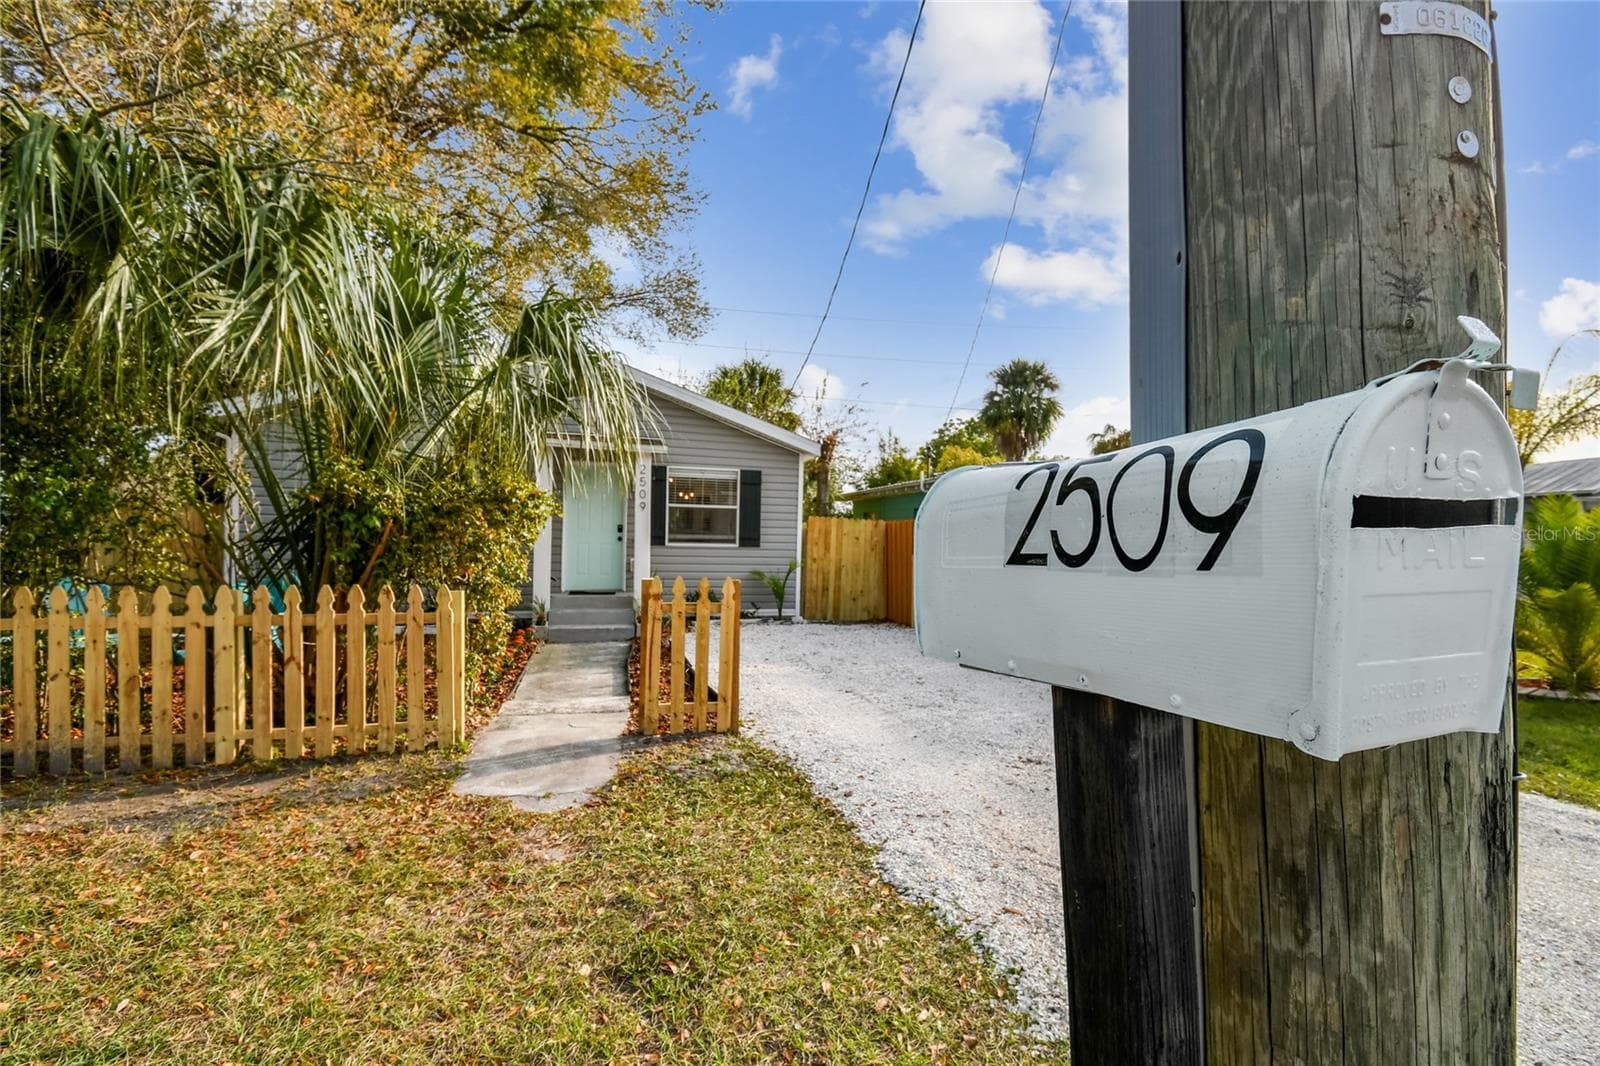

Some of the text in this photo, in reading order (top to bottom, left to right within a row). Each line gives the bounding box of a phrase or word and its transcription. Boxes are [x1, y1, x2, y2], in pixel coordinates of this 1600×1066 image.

[639, 465, 647, 512] 2509
[1005, 428, 1266, 572] 2509
[1377, 528, 1486, 571] MAIL
